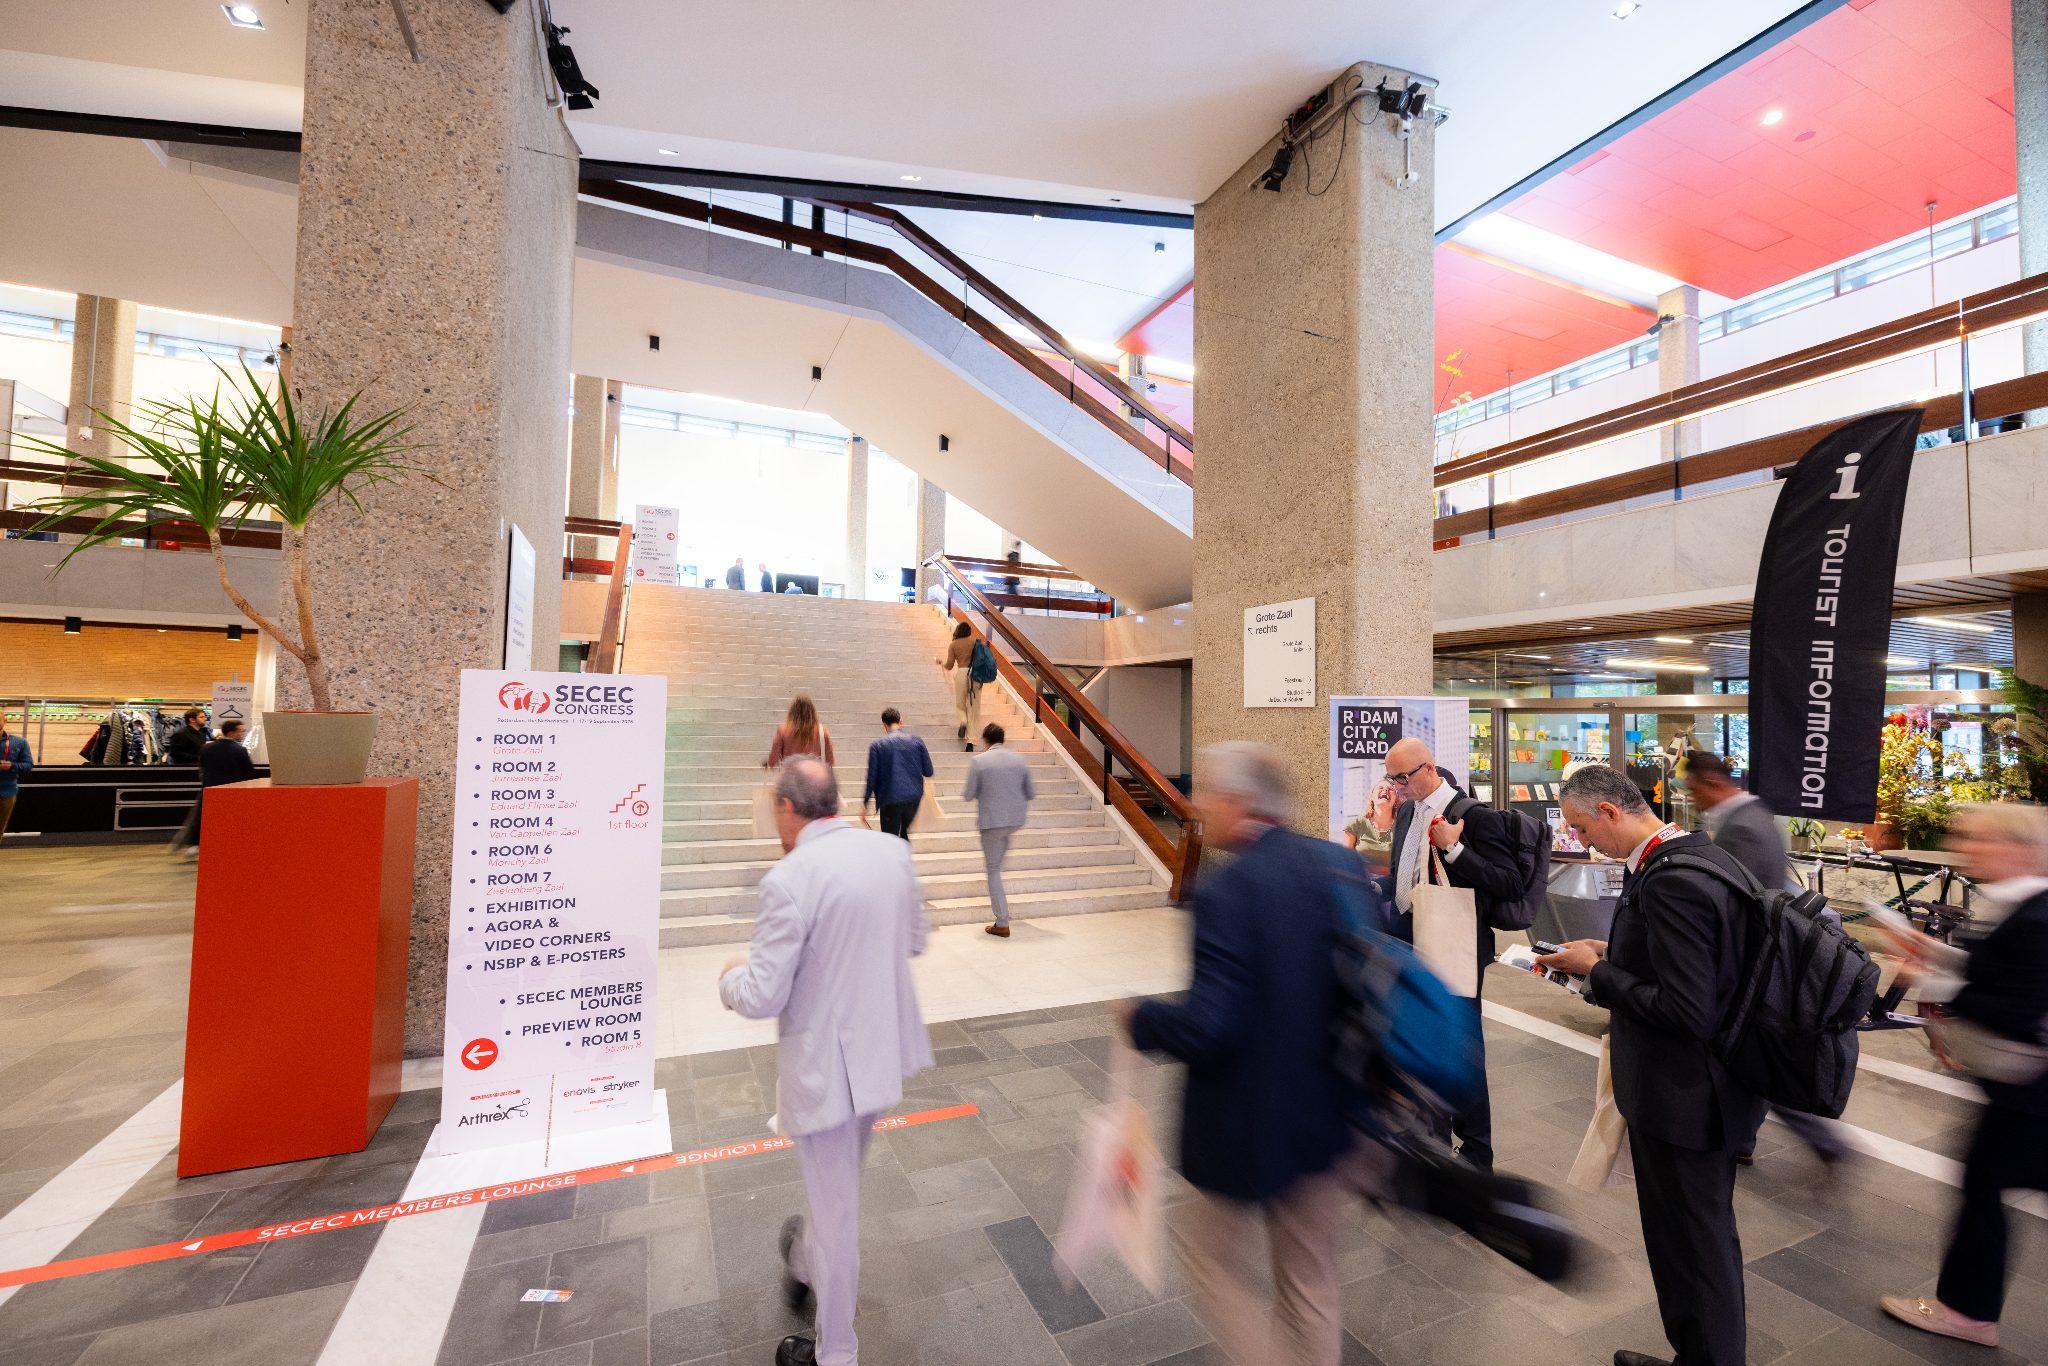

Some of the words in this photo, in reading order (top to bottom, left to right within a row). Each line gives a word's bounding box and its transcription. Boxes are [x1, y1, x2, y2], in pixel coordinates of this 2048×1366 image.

[1256, 612, 1275, 623] Grote
[1277, 609, 1293, 620] Zaal
[1255, 624, 1278, 635] rechts
[555, 685, 634, 703] SECEC
[554, 704, 634, 716] CONGRESS
[494, 734, 543, 745] ROOM
[549, 734, 556, 745] 1
[1343, 741, 1389, 754] CARD
[492, 762, 542, 773] ROOM
[548, 762, 556, 772] 2
[543, 773, 563, 782] Zaal
[491, 789, 541, 801] ROOM
[546, 789, 555, 799] 3
[558, 800, 578, 809] Zaal
[490, 817, 540, 829] ROOM
[545, 816, 553, 827] 4
[609, 820, 622, 829] 1st
[623, 820, 649, 829] floor
[490, 830, 507, 838] Van
[561, 827, 581, 836] Zaal
[489, 845, 539, 857] ROOM
[544, 844, 553, 855] 6
[529, 857, 549, 865] Zaal
[488, 872, 537, 885] ROOM
[543, 872, 551, 882] 7
[545, 883, 565, 892] Zaal
[486, 898, 576, 914] EXHIBITION
[484, 918, 543, 933] AGORA
[549, 917, 560, 928] &
[484, 937, 535, 952] VIDEO
[540, 931, 611, 947] CORNERS
[484, 957, 526, 971] NSBP
[530, 956, 541, 966] &
[547, 948, 626, 965] E-POSTERS
[517, 990, 565, 1005] SECEC
[570, 981, 643, 999] MEMBERS
[580, 994, 642, 1011] LOUNGE
[522, 1017, 591, 1036] PREVIEW
[595, 1012, 642, 1027] ROOM
[581, 1031, 628, 1047] ROOM
[633, 1030, 641, 1040] 5
[563, 1087, 596, 1098] enovis
[603, 1080, 640, 1092] stryker
[458, 1110, 511, 1127] Arthrex
[674, 1144, 757, 1164] LOUNGE
[257, 1216, 347, 1240] SECEC
[352, 1193, 474, 1223] MEMBERS
[480, 1174, 577, 1200] LOUNGE
